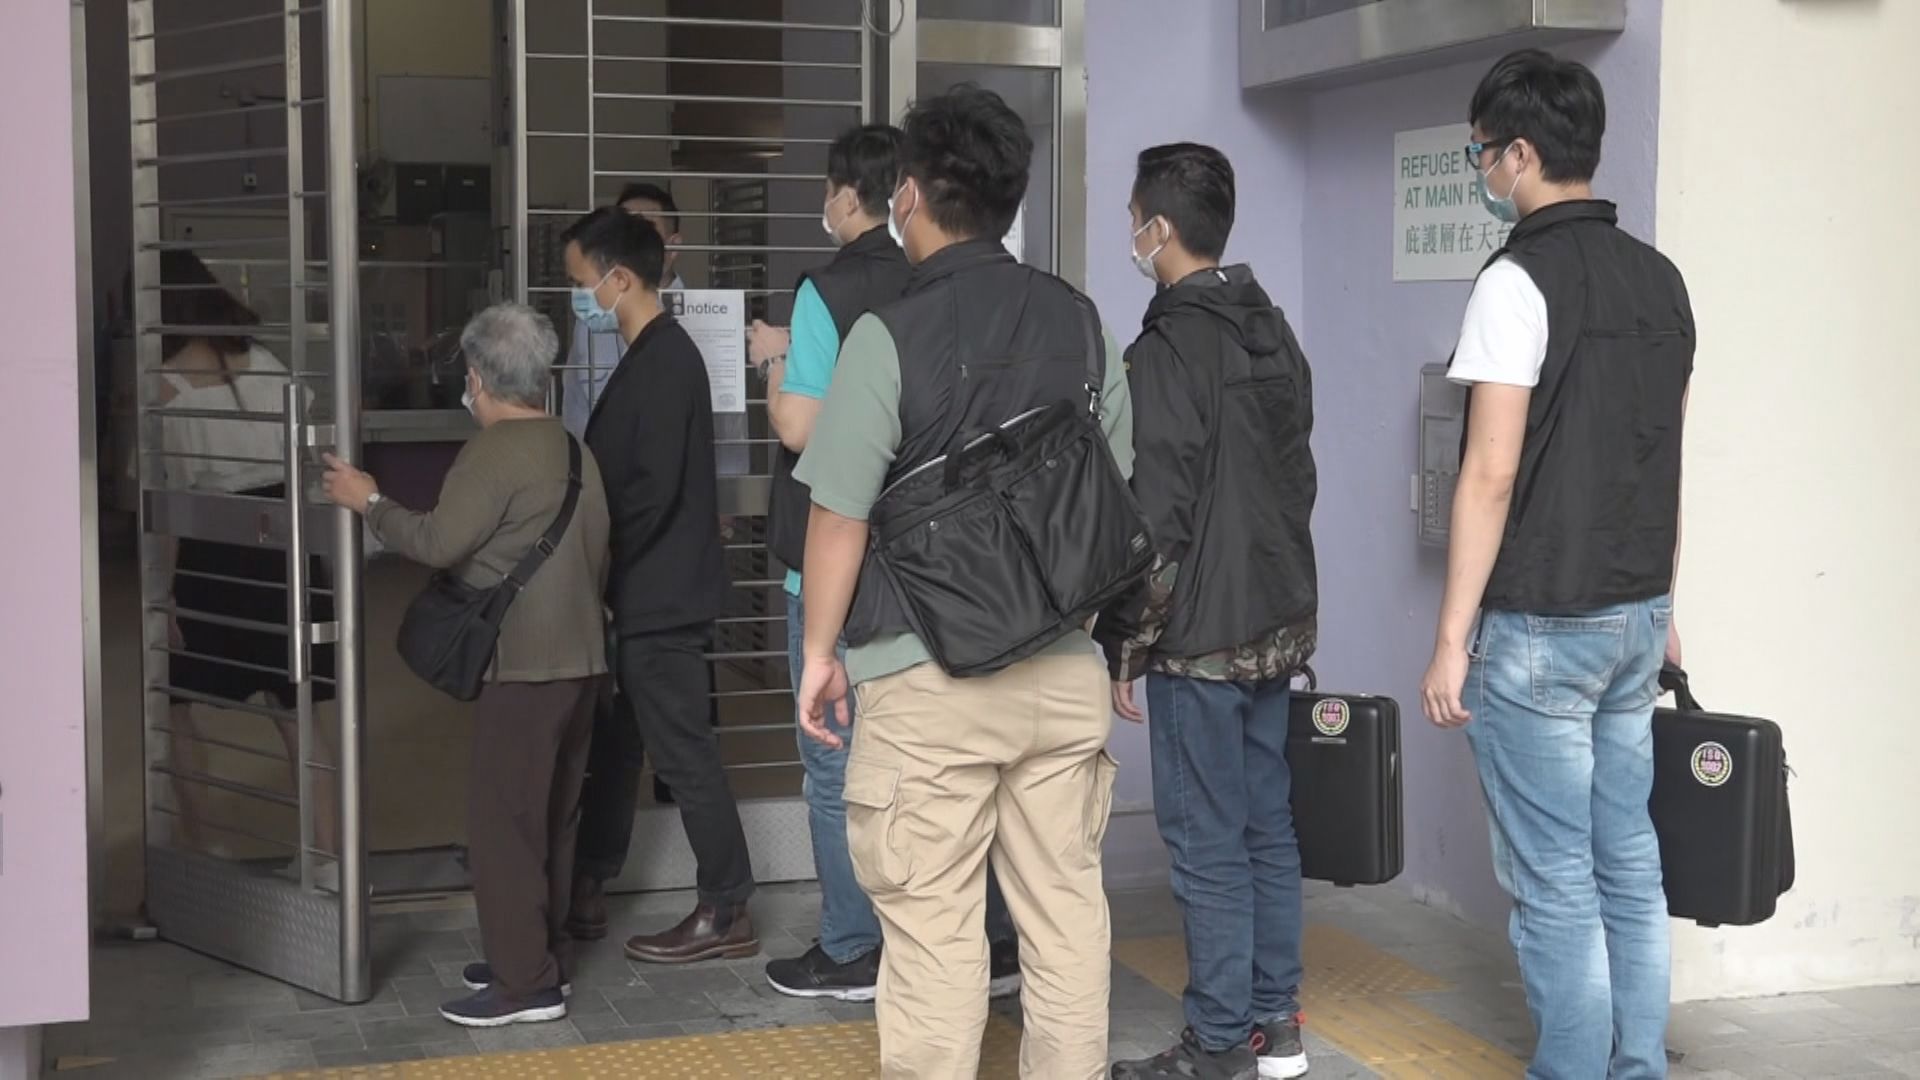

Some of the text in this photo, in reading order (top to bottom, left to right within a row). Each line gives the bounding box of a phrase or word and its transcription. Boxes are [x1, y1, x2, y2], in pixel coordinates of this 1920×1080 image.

[1401, 151, 1459, 178] REFUGE
[1404, 188, 1422, 209] AT
[1425, 183, 1463, 208] MAIN
[687, 303, 729, 314] notice
